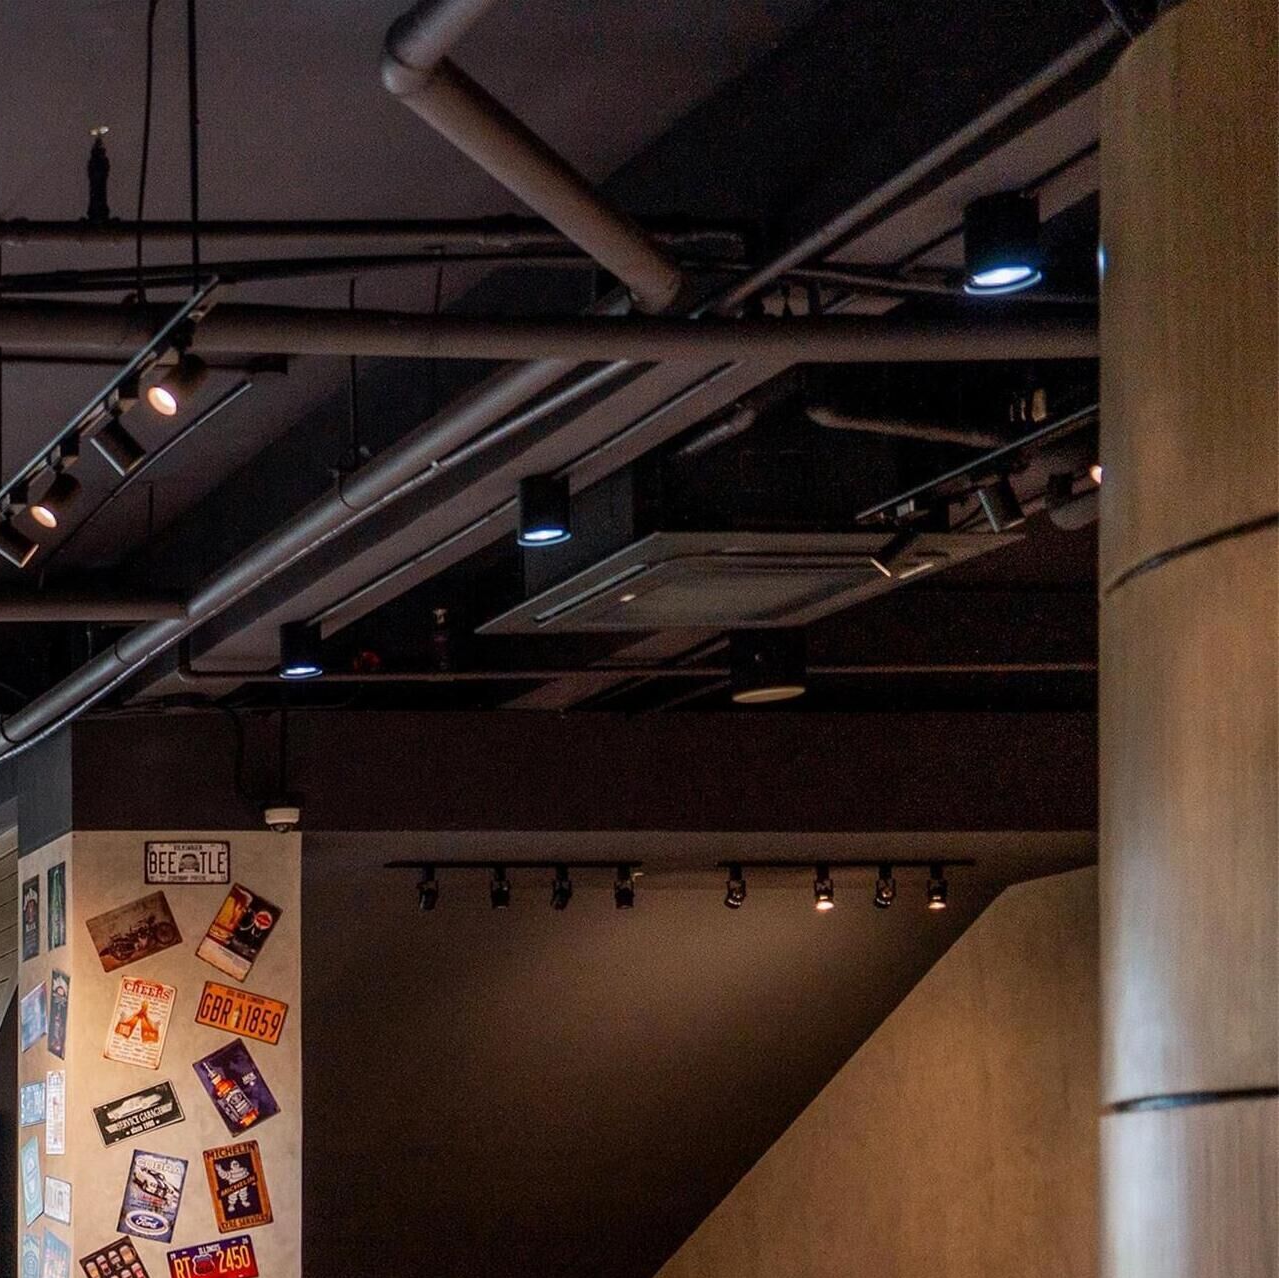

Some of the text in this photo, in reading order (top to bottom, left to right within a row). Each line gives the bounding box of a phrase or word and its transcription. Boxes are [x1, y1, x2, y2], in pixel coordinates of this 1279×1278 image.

[124, 982, 171, 1000] CHEERS
[200, 993, 281, 1038] GBR 1859
[205, 1142, 256, 1159] MICHELIN
[136, 1158, 181, 1174] COBRA
[136, 1215, 159, 1229] Ford
[216, 1244, 251, 1274] 2450
